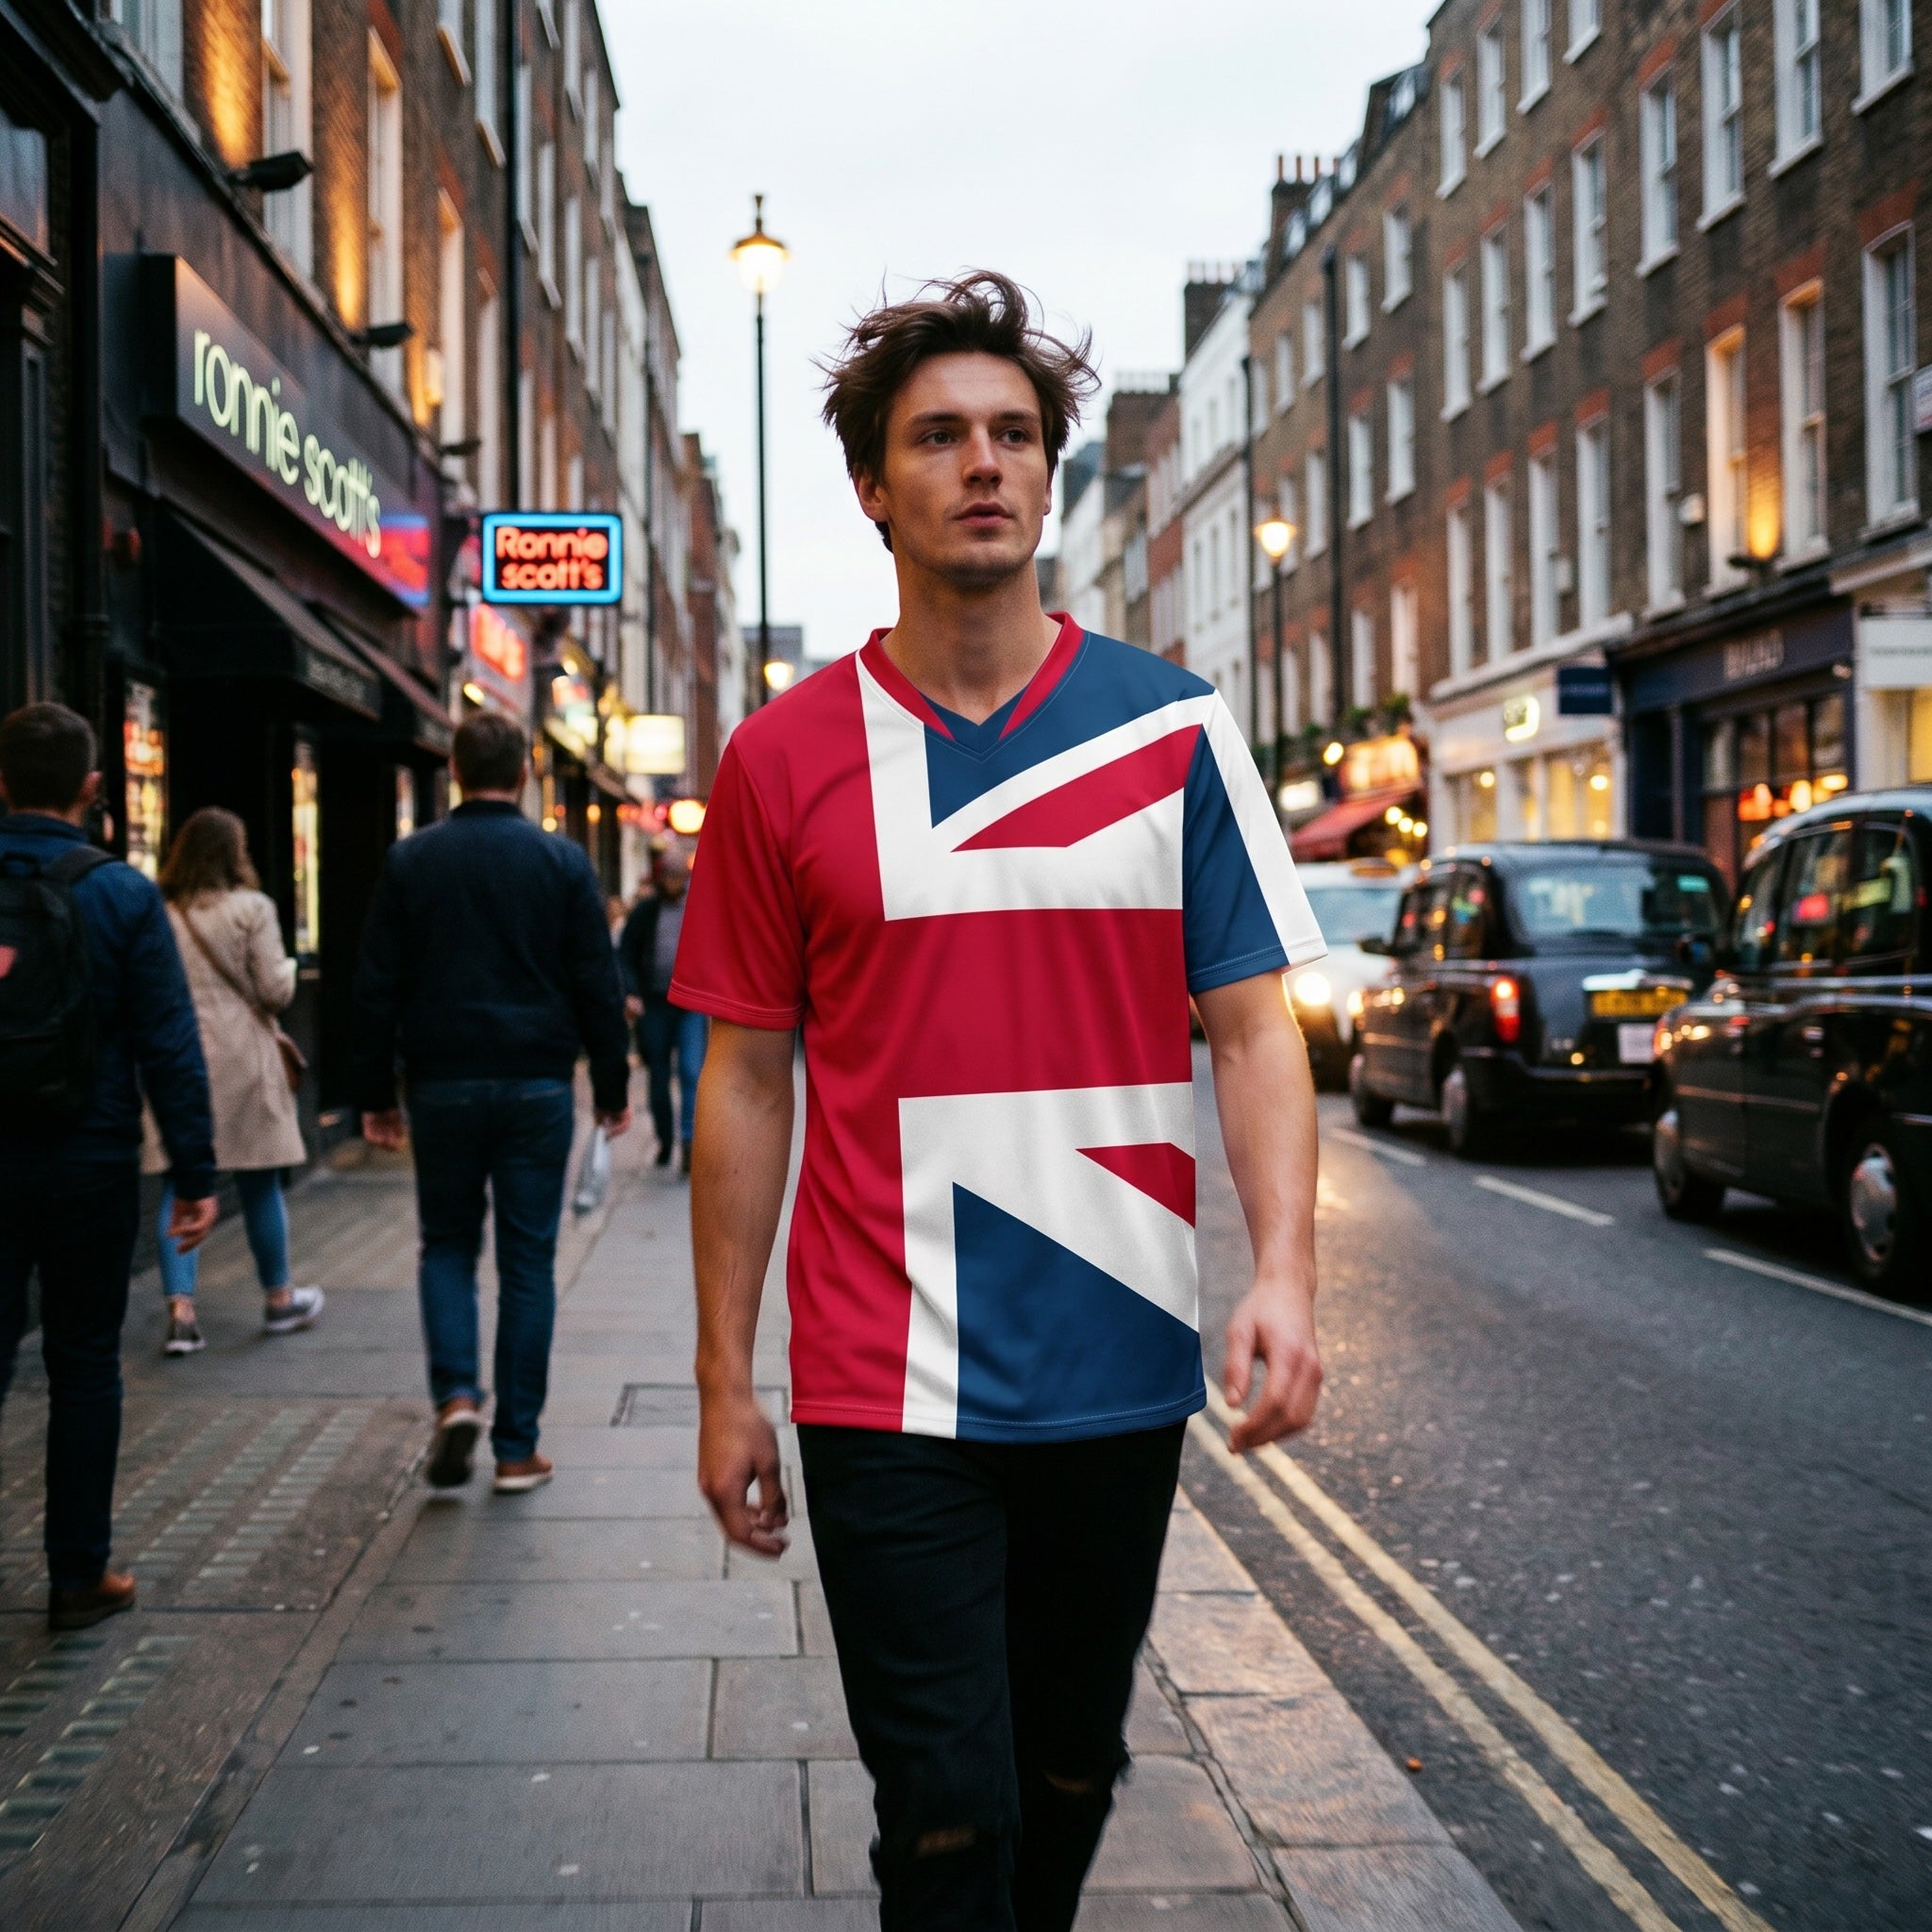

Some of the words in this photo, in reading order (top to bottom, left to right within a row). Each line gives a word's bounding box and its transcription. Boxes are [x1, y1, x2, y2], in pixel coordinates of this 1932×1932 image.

[194, 329, 300, 485] ronnie
[304, 434, 381, 558] scott's
[496, 526, 608, 560] Ronnie
[501, 558, 603, 590] scott's
